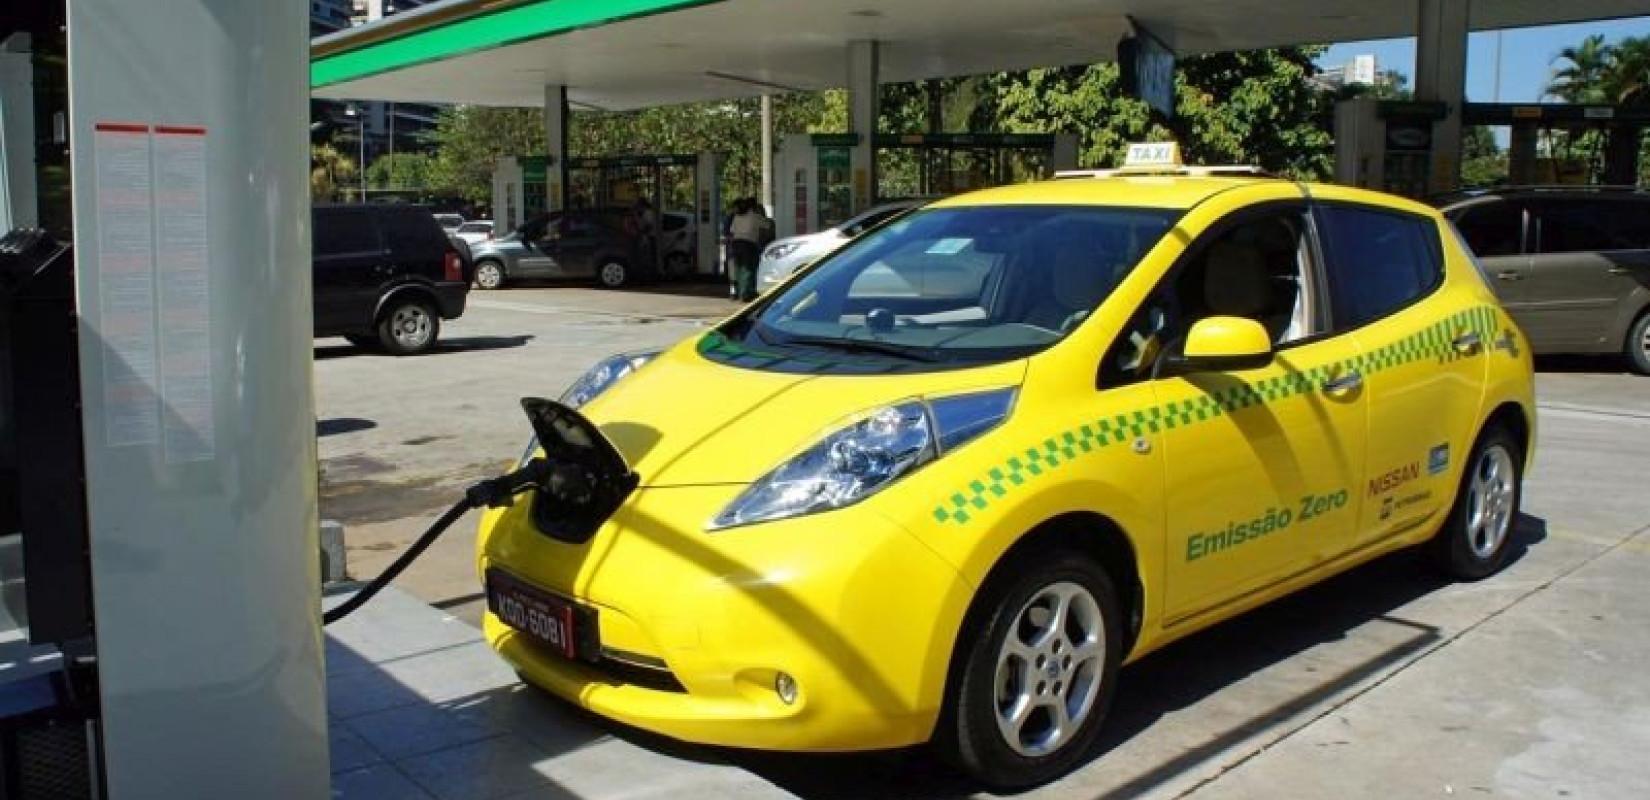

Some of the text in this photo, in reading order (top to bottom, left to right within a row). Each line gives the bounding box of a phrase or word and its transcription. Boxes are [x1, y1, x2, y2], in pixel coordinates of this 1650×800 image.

[1368, 461, 1420, 497] NISSAN
[1186, 505, 1292, 562] Emissão
[1298, 488, 1348, 522] Zero
